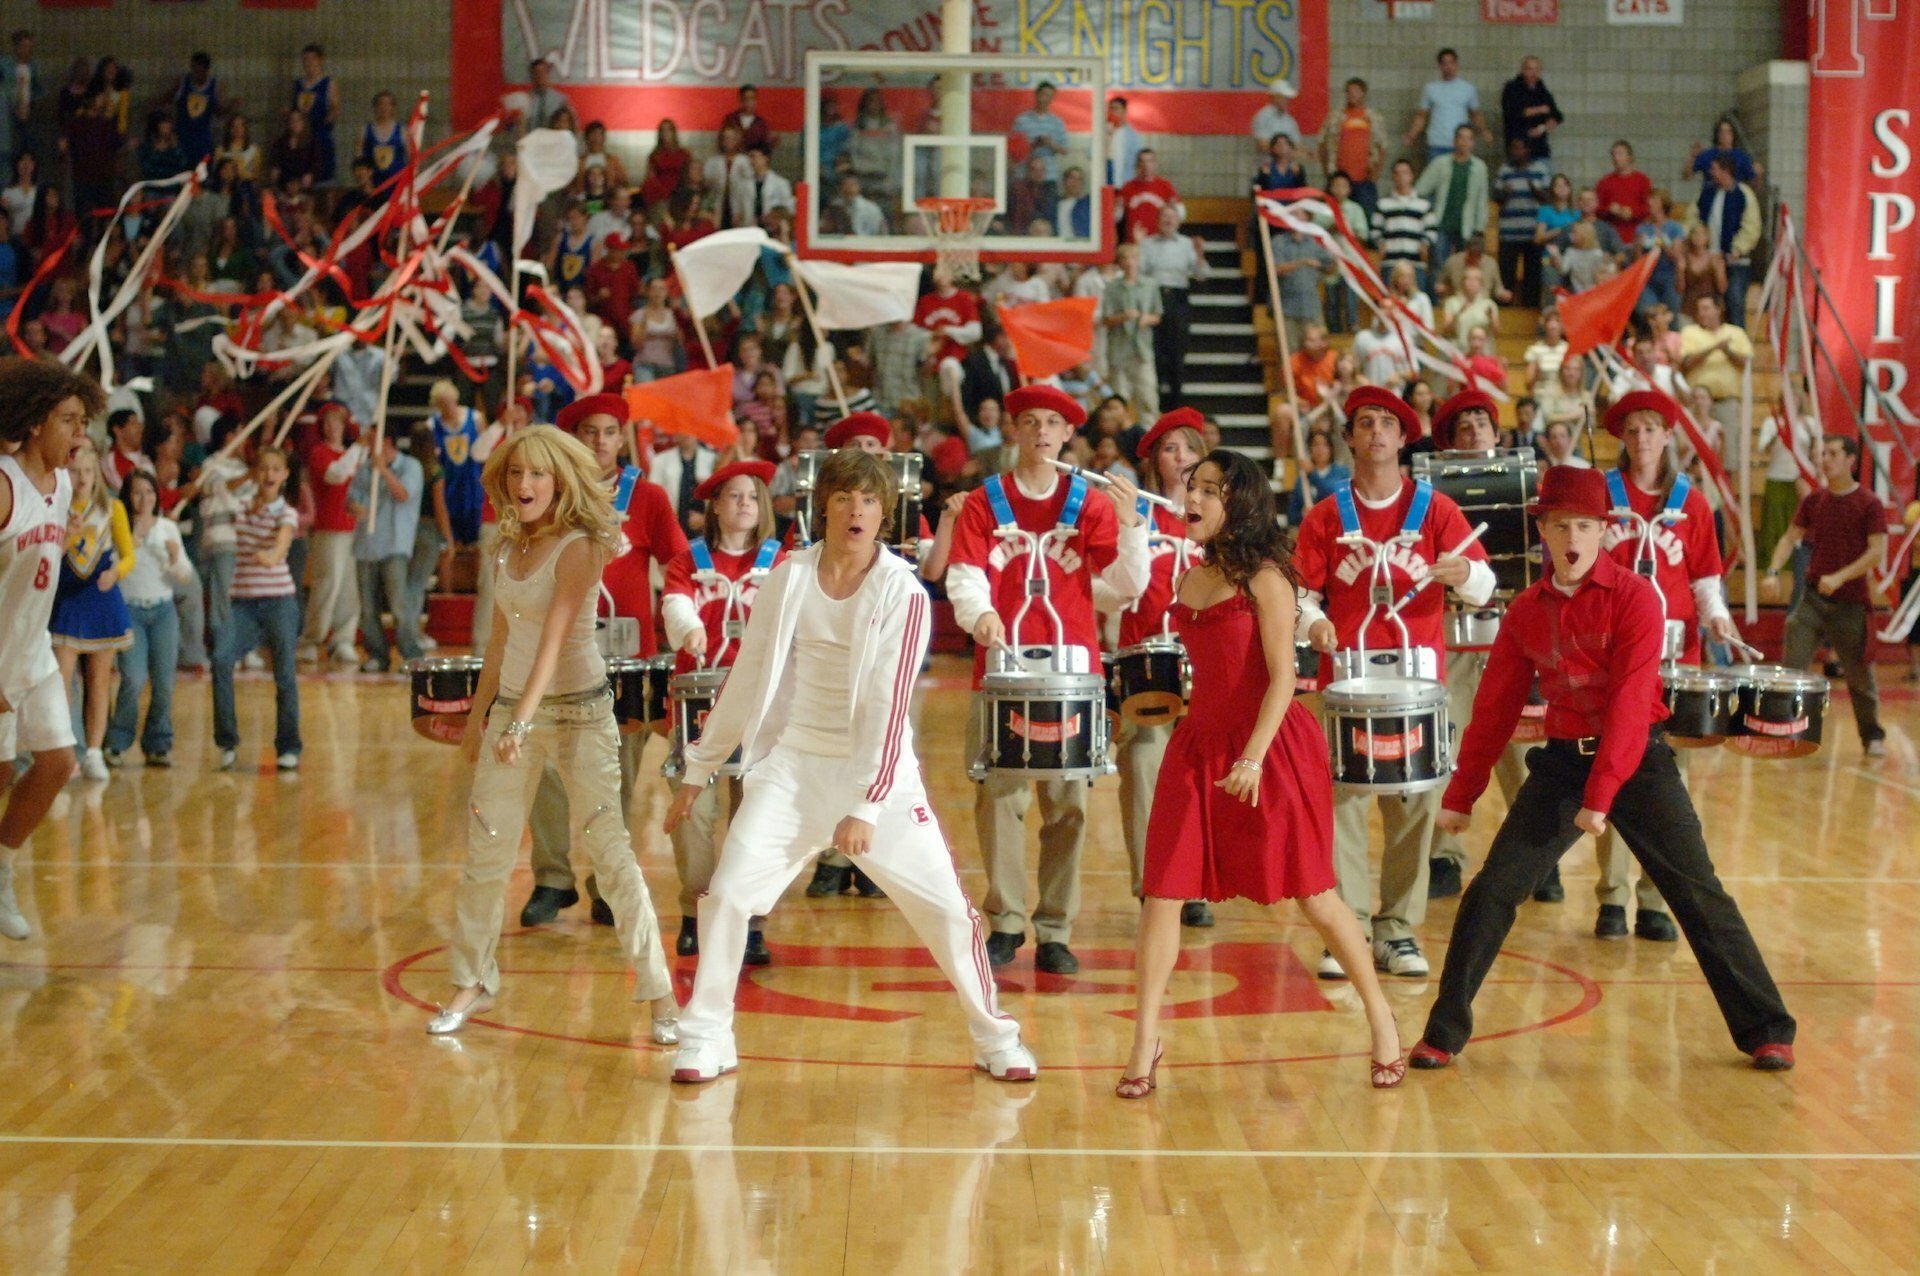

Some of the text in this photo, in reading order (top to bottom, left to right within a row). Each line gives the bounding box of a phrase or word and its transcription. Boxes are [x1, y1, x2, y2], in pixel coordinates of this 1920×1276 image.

[506, 0, 846, 81] WILDCATS
[1013, 0, 1294, 87] KNIGHTS
[34, 556, 51, 592] 8
[913, 806, 930, 823] E
